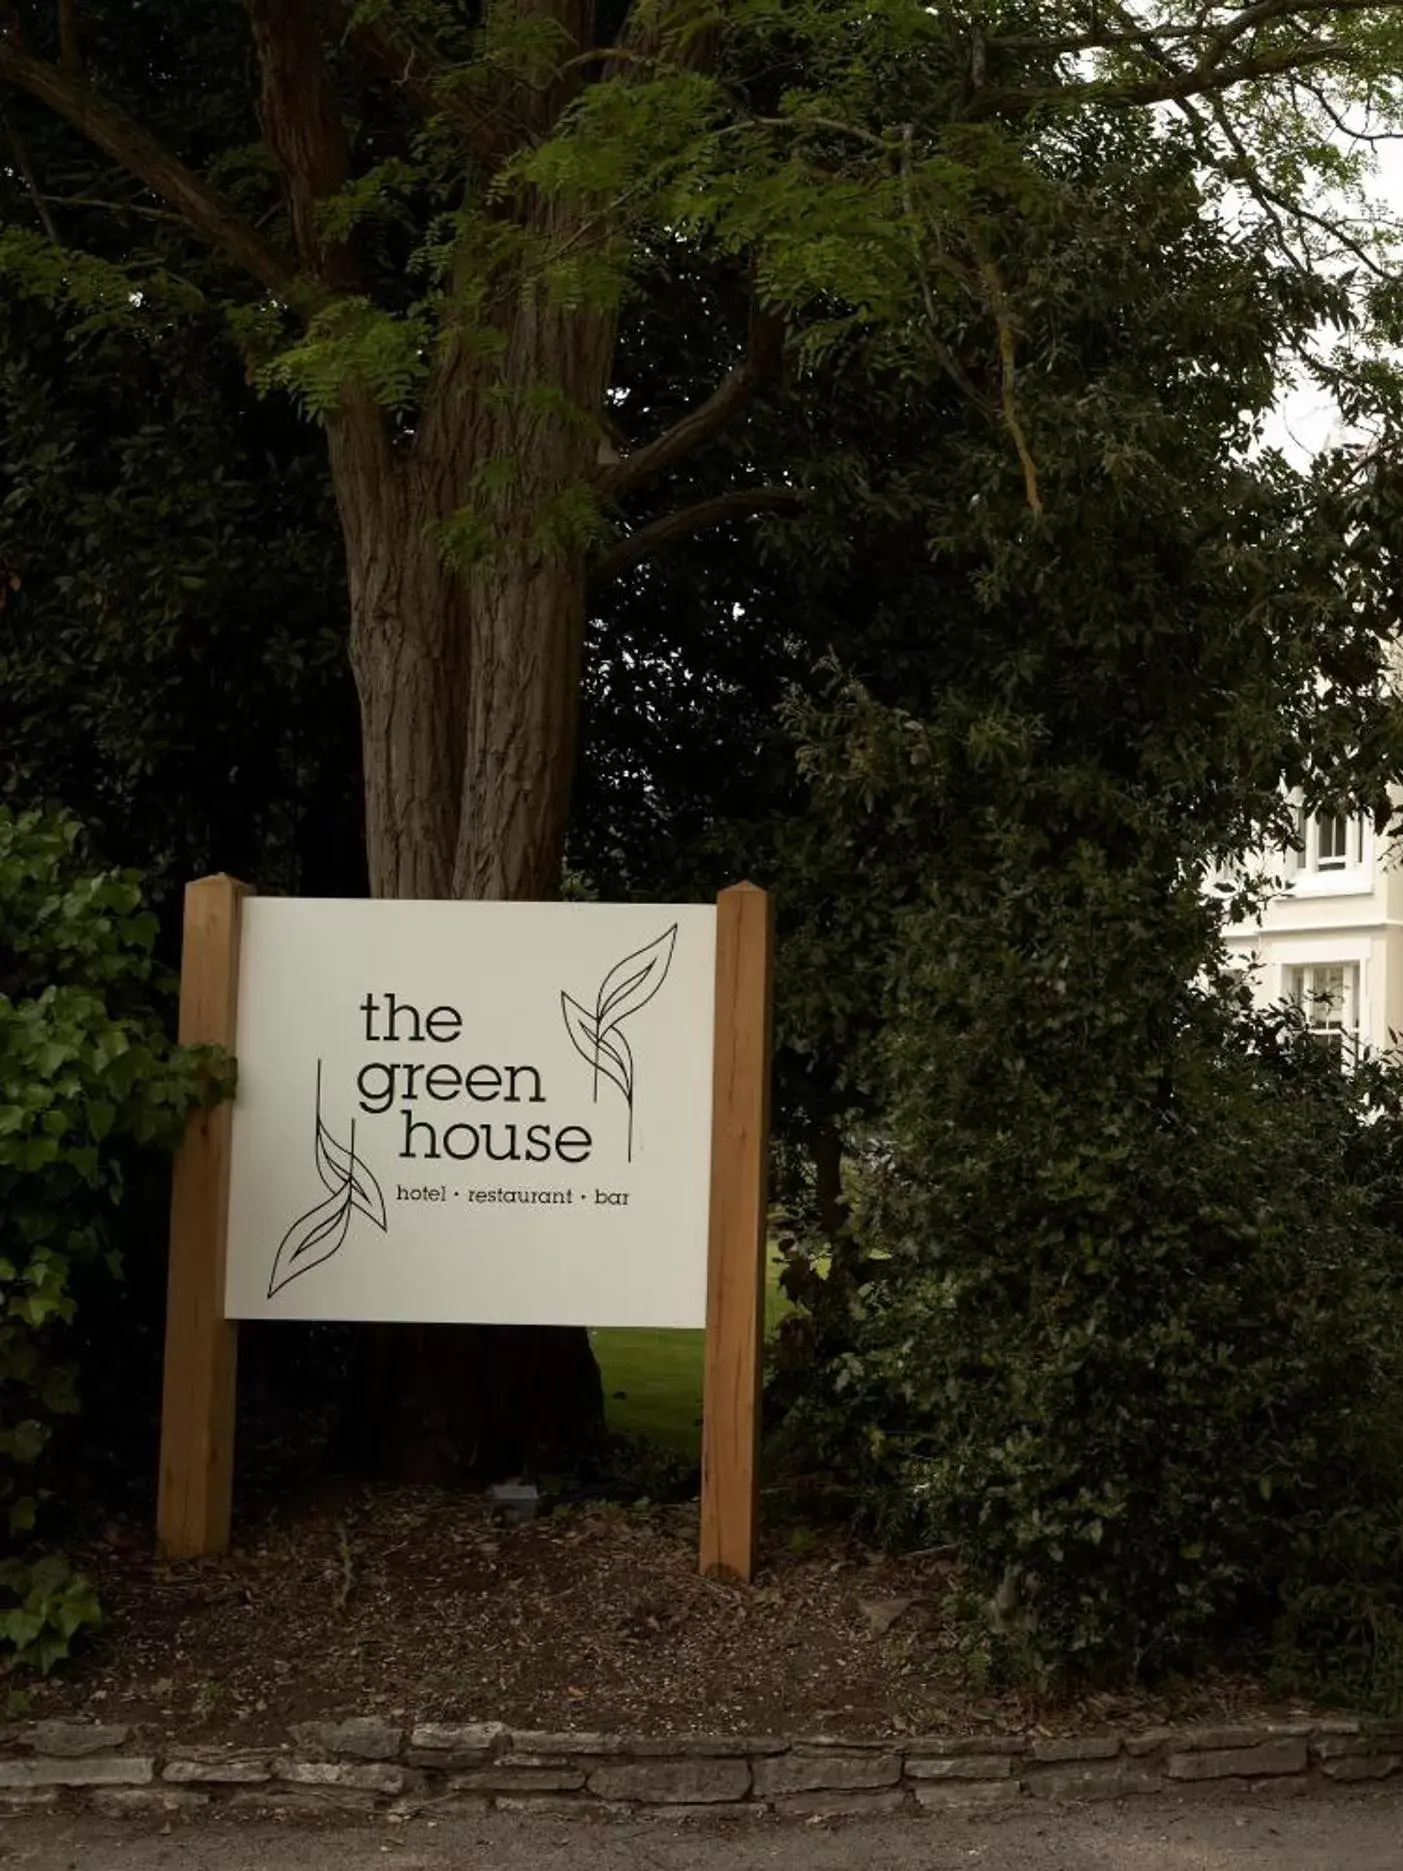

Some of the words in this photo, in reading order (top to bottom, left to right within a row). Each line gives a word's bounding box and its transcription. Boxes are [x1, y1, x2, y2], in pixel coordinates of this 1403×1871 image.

[359, 992, 463, 1043] the
[356, 1062, 547, 1115] green
[397, 1108, 593, 1164] house
[396, 1183, 447, 1203] hotel
[467, 1187, 574, 1205] restaurant
[593, 1188, 630, 1206] bar
